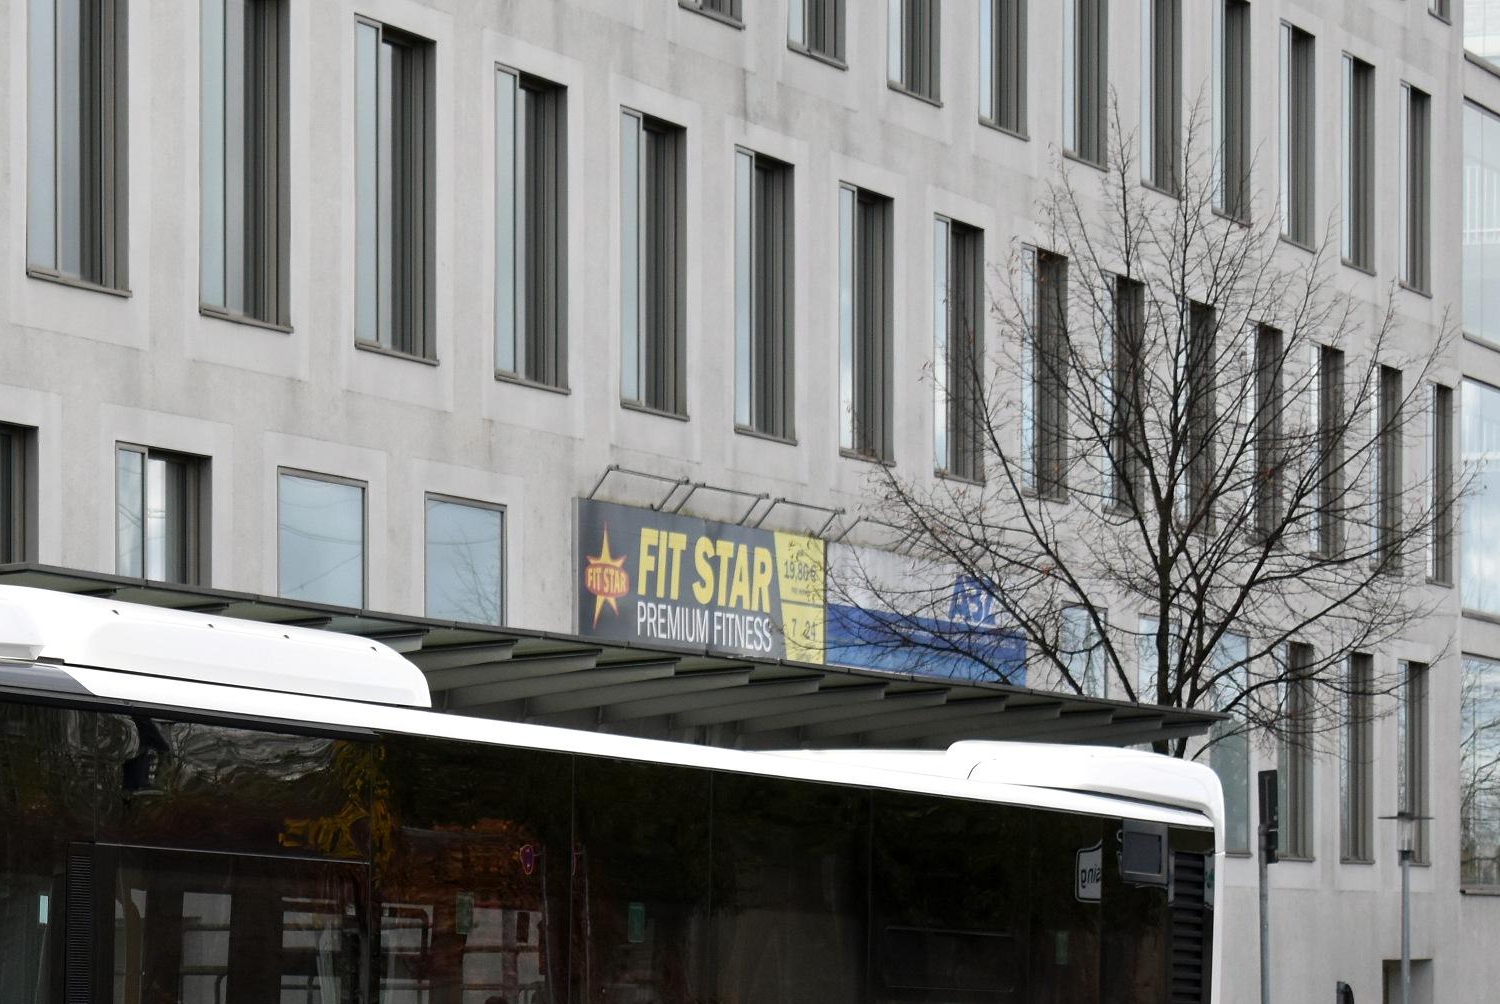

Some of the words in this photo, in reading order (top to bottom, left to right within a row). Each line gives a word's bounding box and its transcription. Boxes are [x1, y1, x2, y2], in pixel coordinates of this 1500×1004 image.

[587, 567, 602, 592] FIT
[603, 568, 627, 593] STAR
[637, 527, 687, 600] FIT
[692, 536, 773, 614] STAR
[637, 601, 709, 644] PREMIUM
[713, 611, 772, 652] FITNESS
